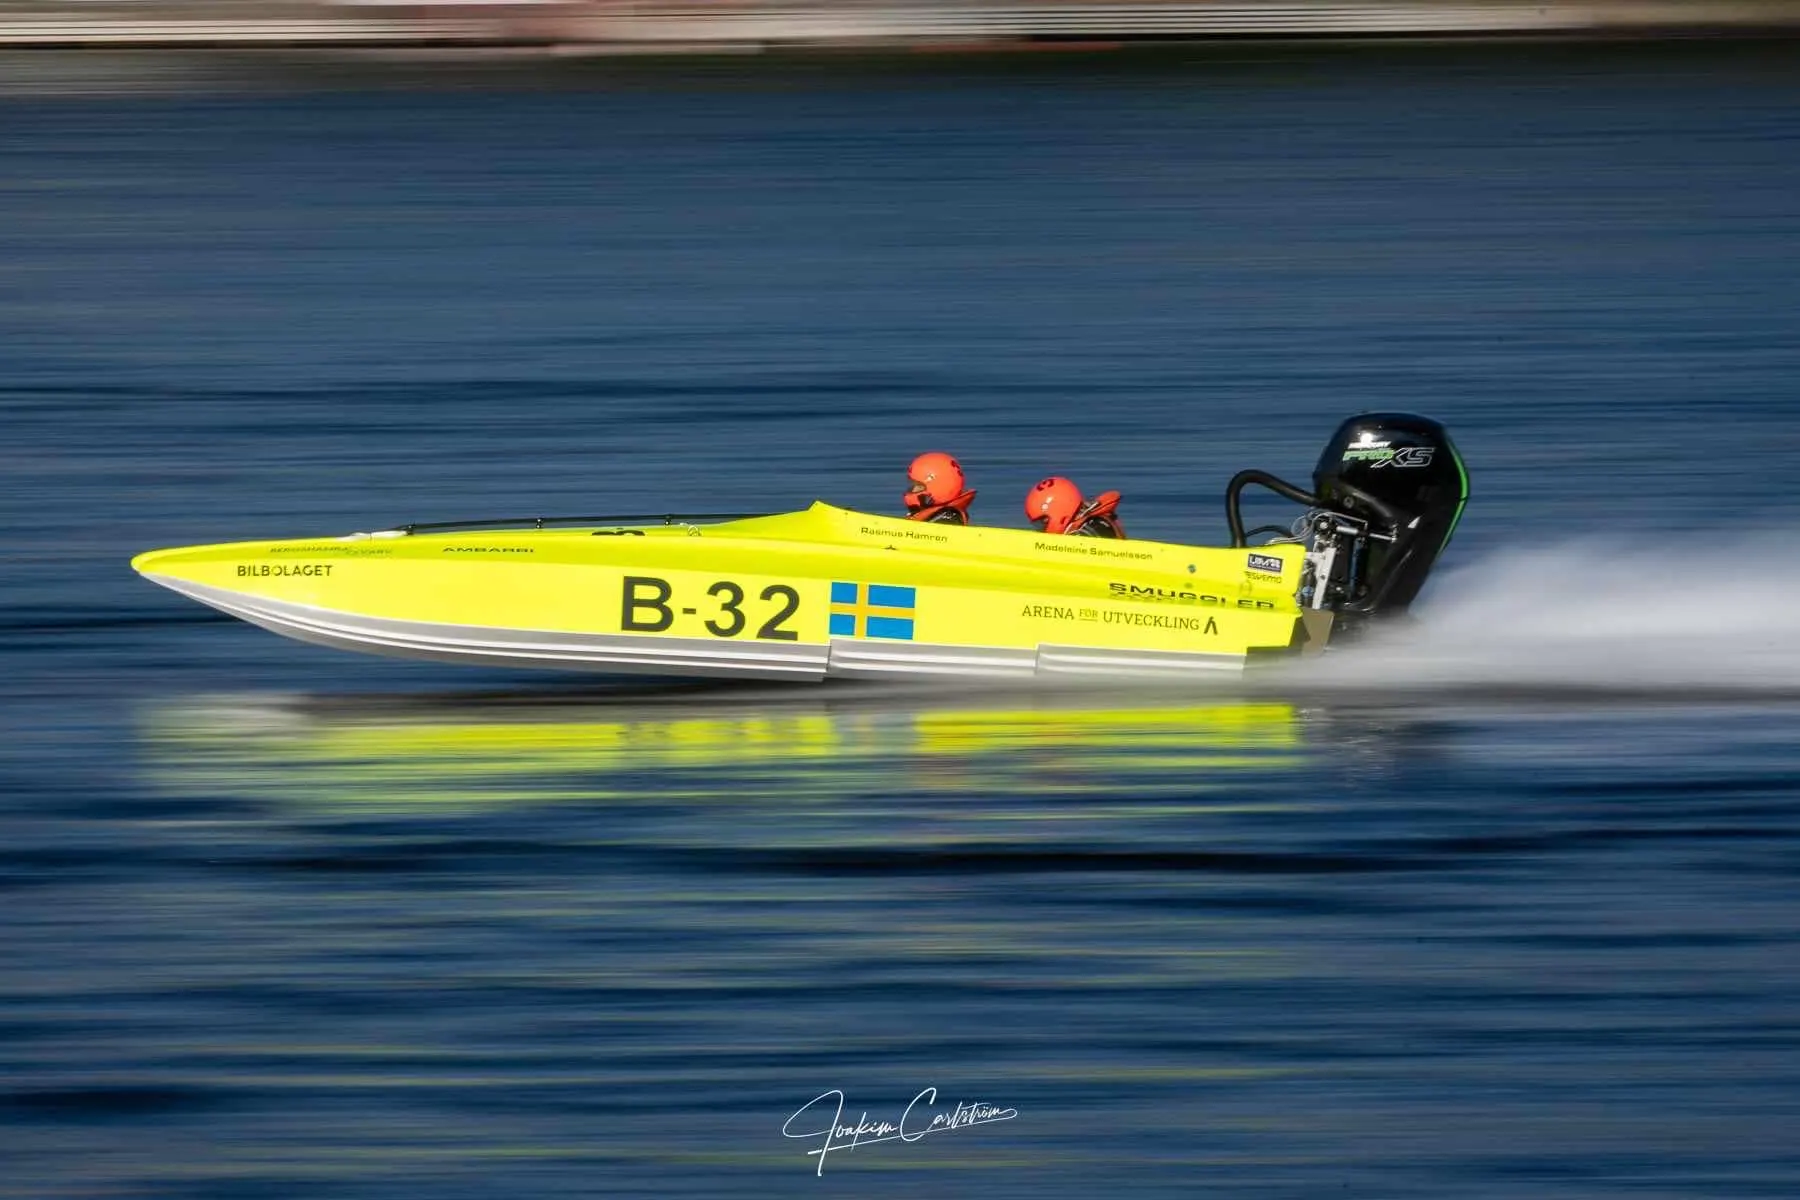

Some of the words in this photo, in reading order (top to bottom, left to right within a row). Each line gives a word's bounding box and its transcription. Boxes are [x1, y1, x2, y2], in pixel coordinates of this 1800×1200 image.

[861, 526, 903, 538] Rasmus
[1034, 541, 1088, 555] Madeleine
[1089, 547, 1153, 560] Samuelsson
[236, 564, 333, 577] BILBOLAGET
[621, 575, 800, 641] B-32
[1022, 605, 1075, 620] ARENA
[1102, 610, 1200, 631] UTVECKLING
